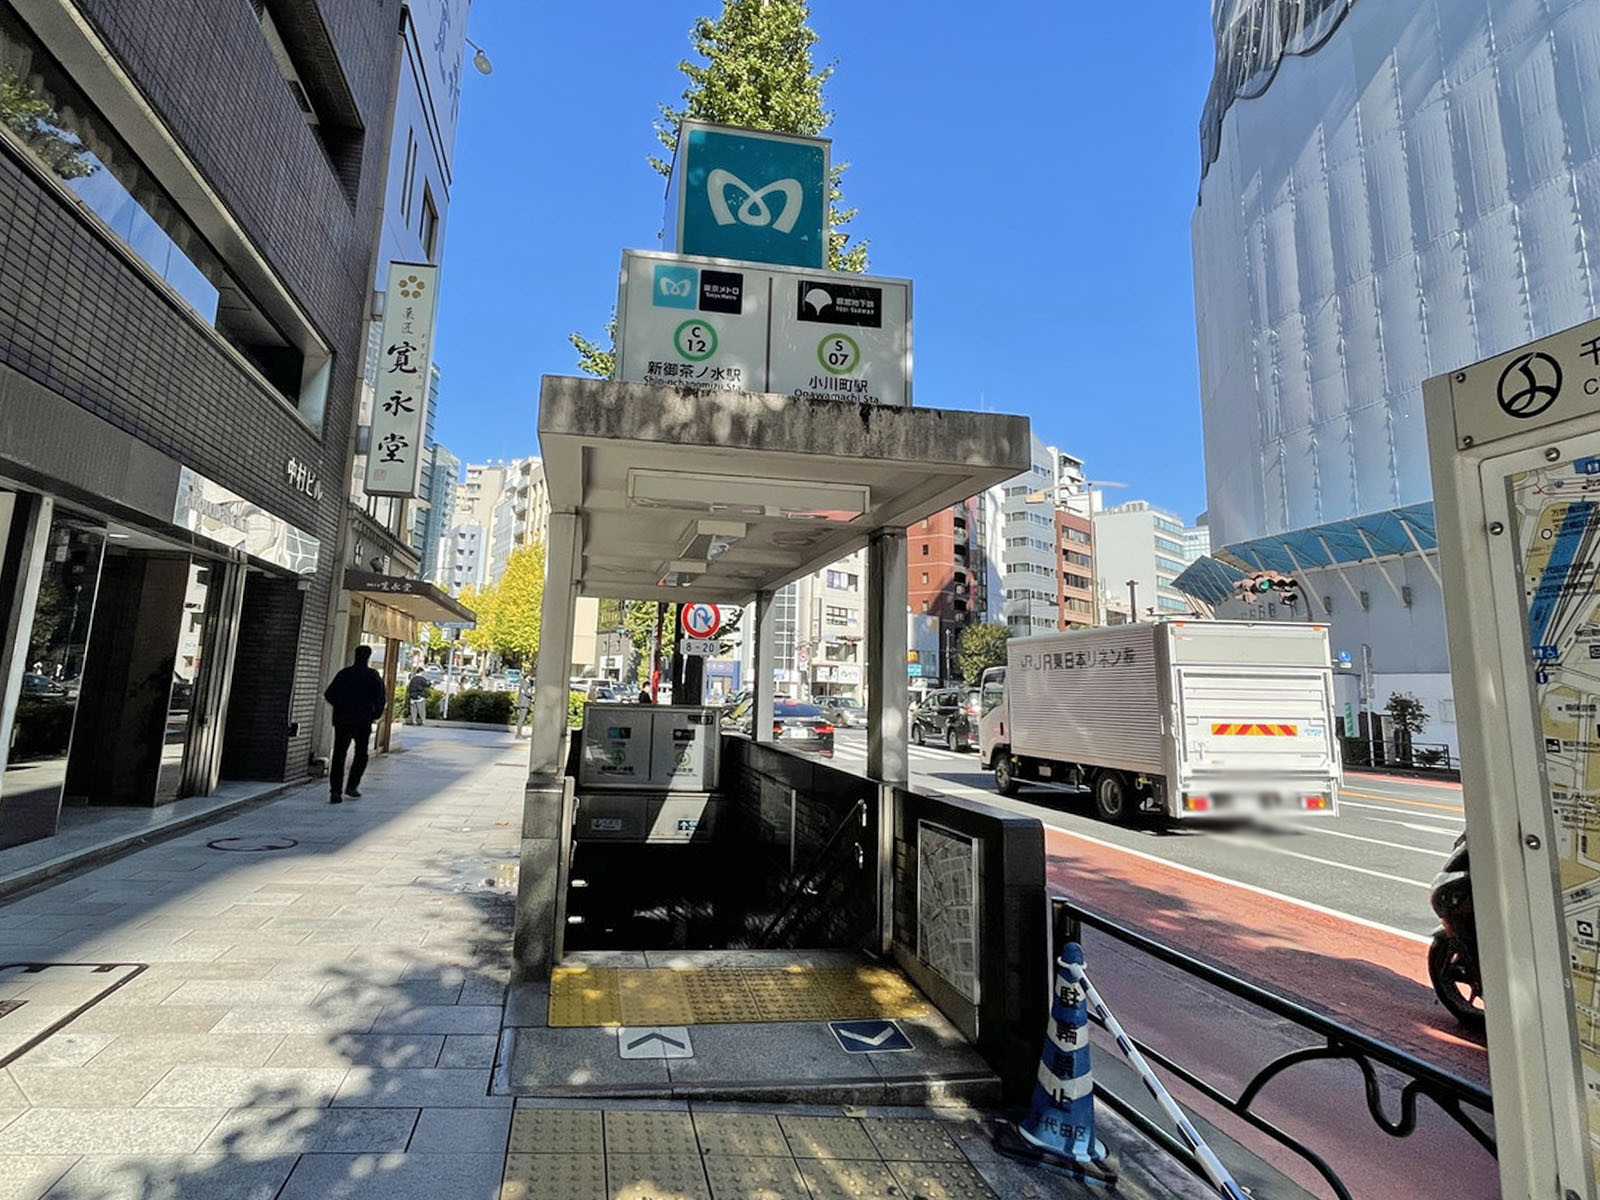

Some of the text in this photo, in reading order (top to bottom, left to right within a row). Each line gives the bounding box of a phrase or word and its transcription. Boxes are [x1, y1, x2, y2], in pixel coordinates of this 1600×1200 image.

[691, 326, 701, 338] C
[687, 339, 706, 352] 12
[835, 340, 843, 352] S
[828, 352, 849, 366] 07
[647, 360, 741, 382] 新御茶ノ水駅
[808, 375, 869, 393] 小川町駅
[376, 340, 418, 464] 寛永堂
